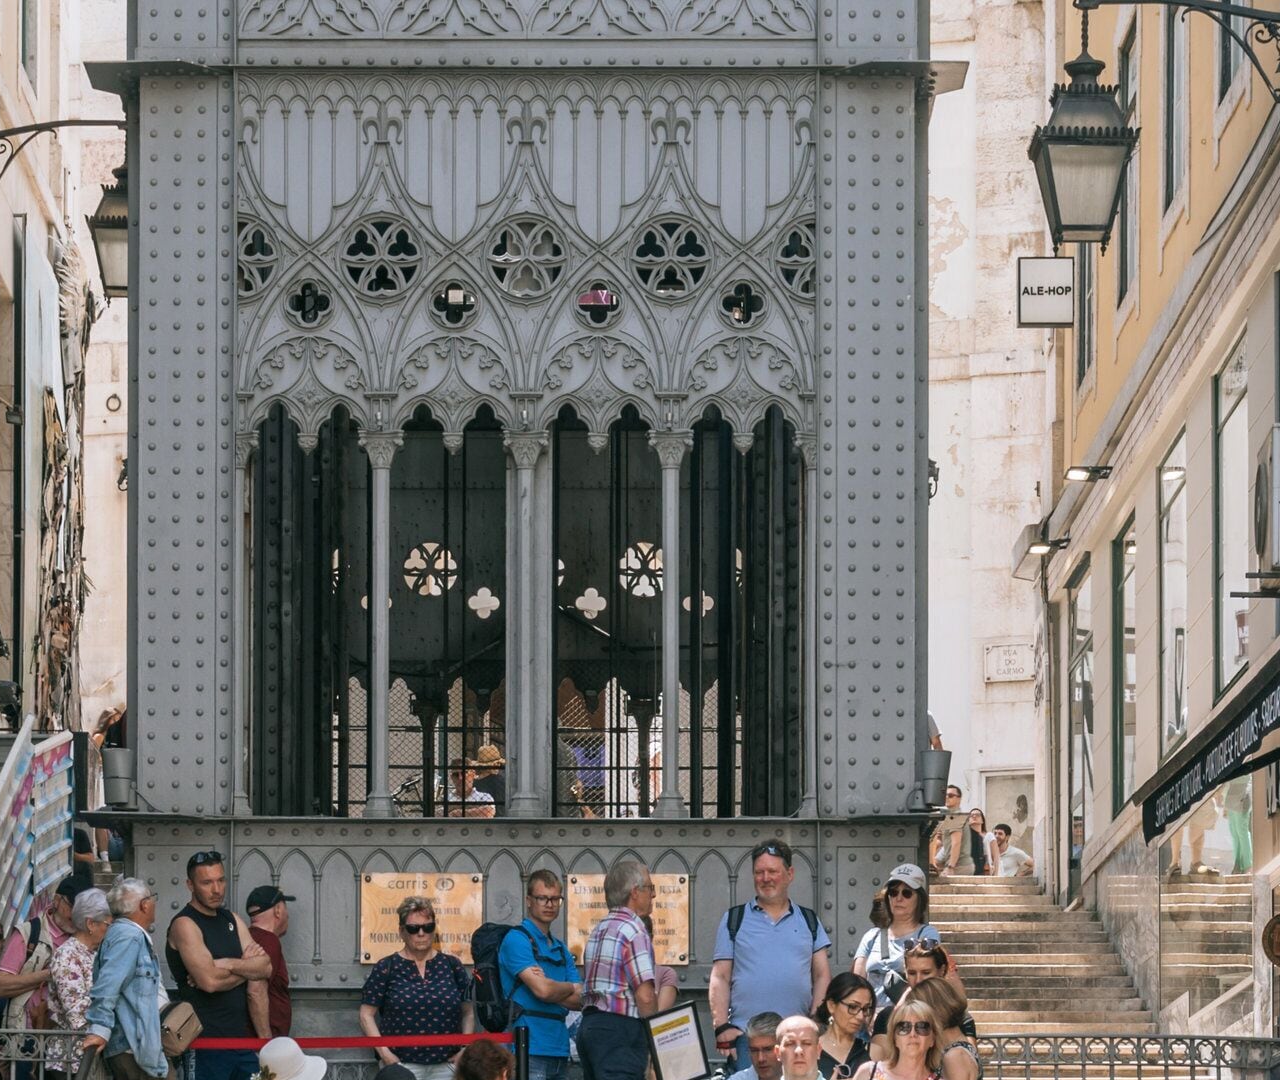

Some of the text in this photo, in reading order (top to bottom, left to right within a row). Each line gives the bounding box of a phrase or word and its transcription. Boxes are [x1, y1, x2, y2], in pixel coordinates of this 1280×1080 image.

[1022, 286, 1071, 296] ALE-HOP
[996, 667, 1024, 676] CARMO
[388, 880, 428, 890] carris
